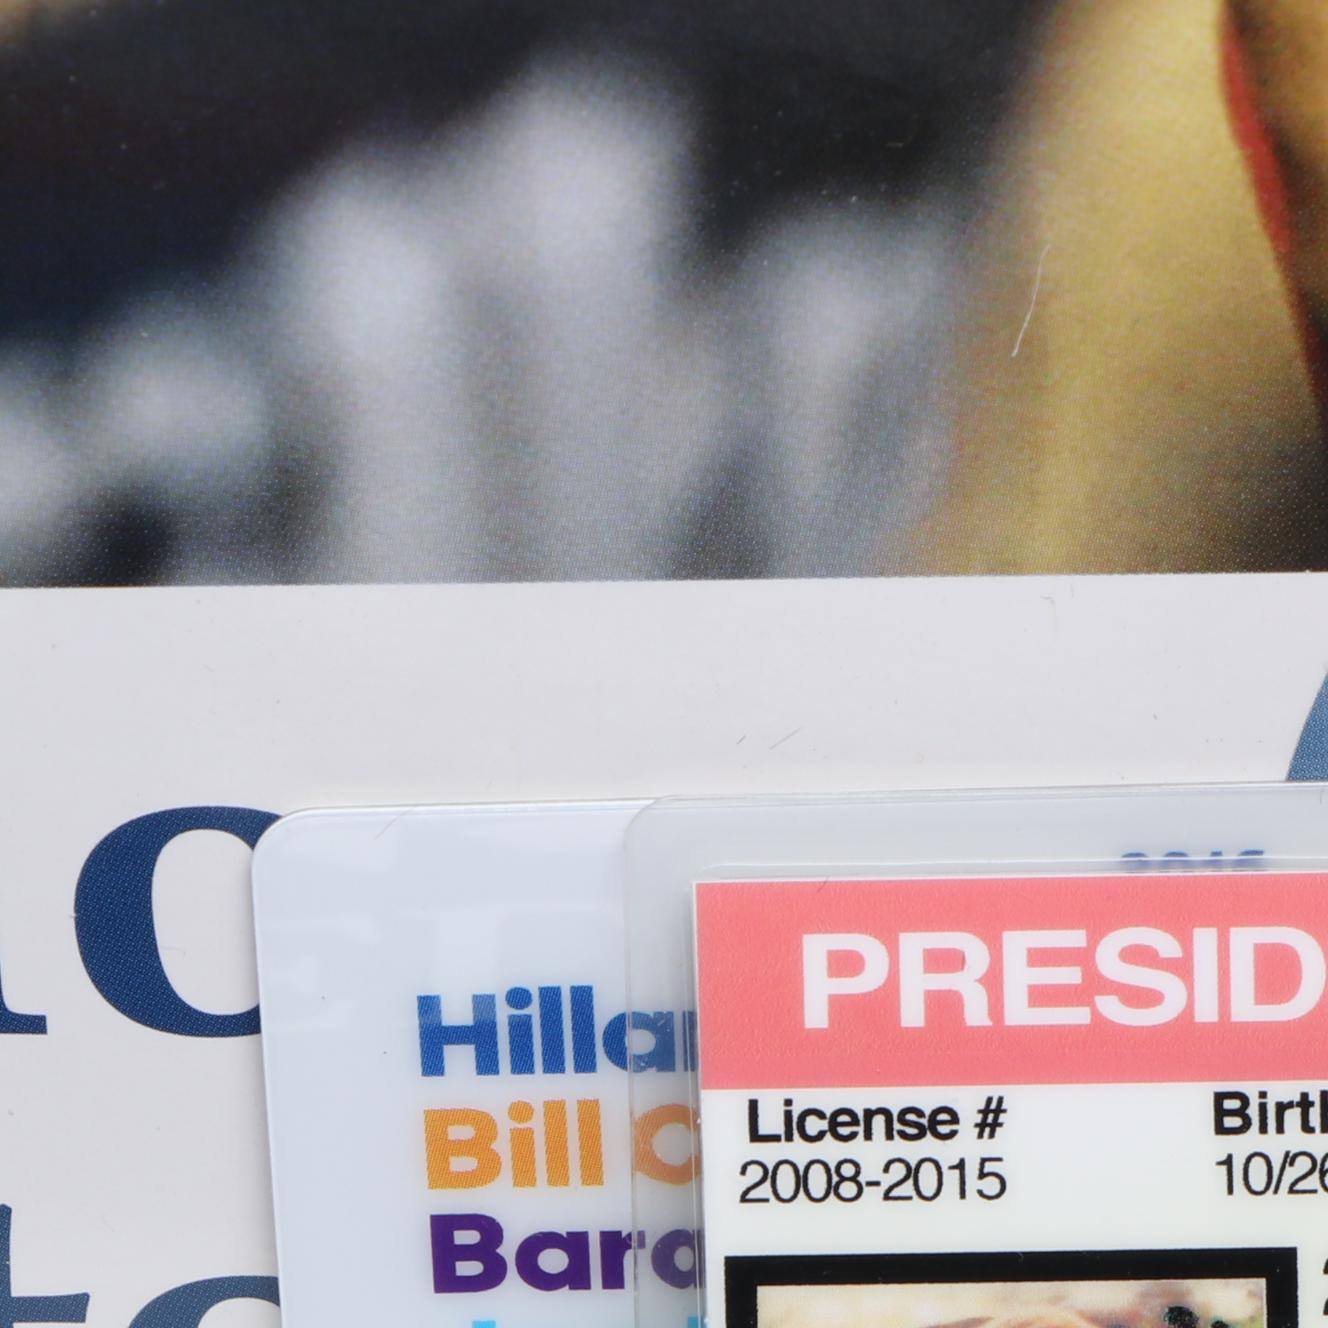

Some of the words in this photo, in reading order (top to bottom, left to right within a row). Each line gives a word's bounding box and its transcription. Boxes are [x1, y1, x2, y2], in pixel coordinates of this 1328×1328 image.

[423, 1098, 604, 1189] Bill
[748, 1097, 959, 1143] License
[974, 1096, 1007, 1140] #
[739, 1156, 1008, 1204] 2008-2015
